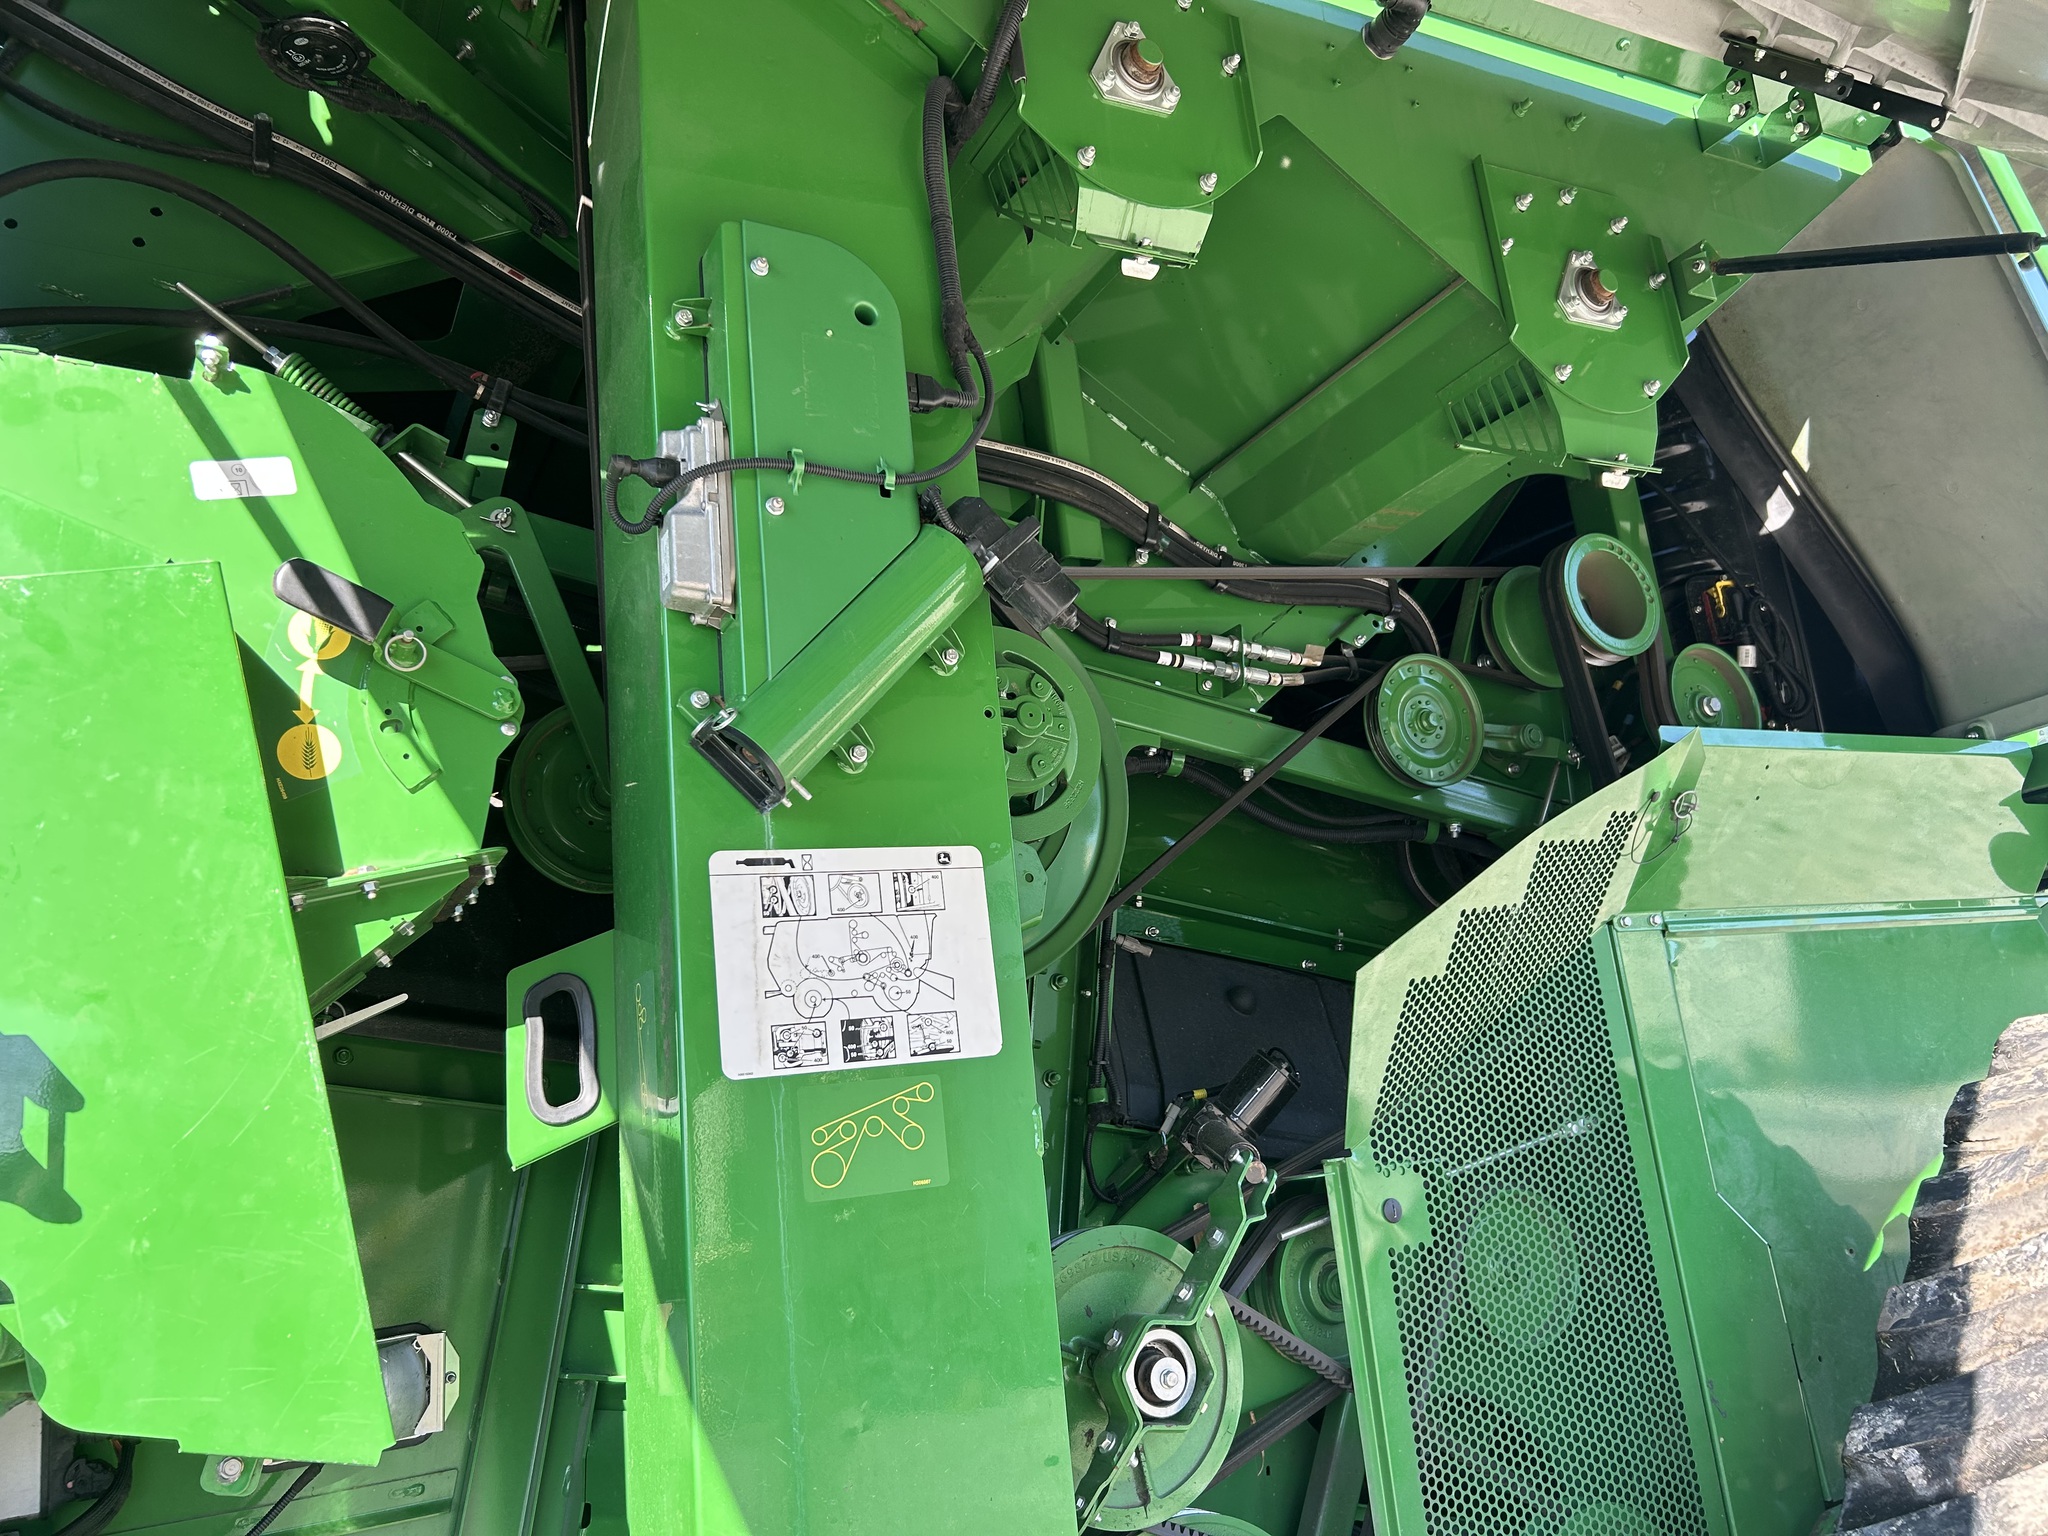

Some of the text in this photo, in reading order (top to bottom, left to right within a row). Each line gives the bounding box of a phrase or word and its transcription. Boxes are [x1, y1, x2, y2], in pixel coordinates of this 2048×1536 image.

[213, 105, 228, 118] BAR
[309, 151, 339, 170] T3012D
[436, 224, 458, 241] T3000
[1002, 444, 1028, 456] RESISTANT
[1026, 450, 1051, 462] ABRASION
